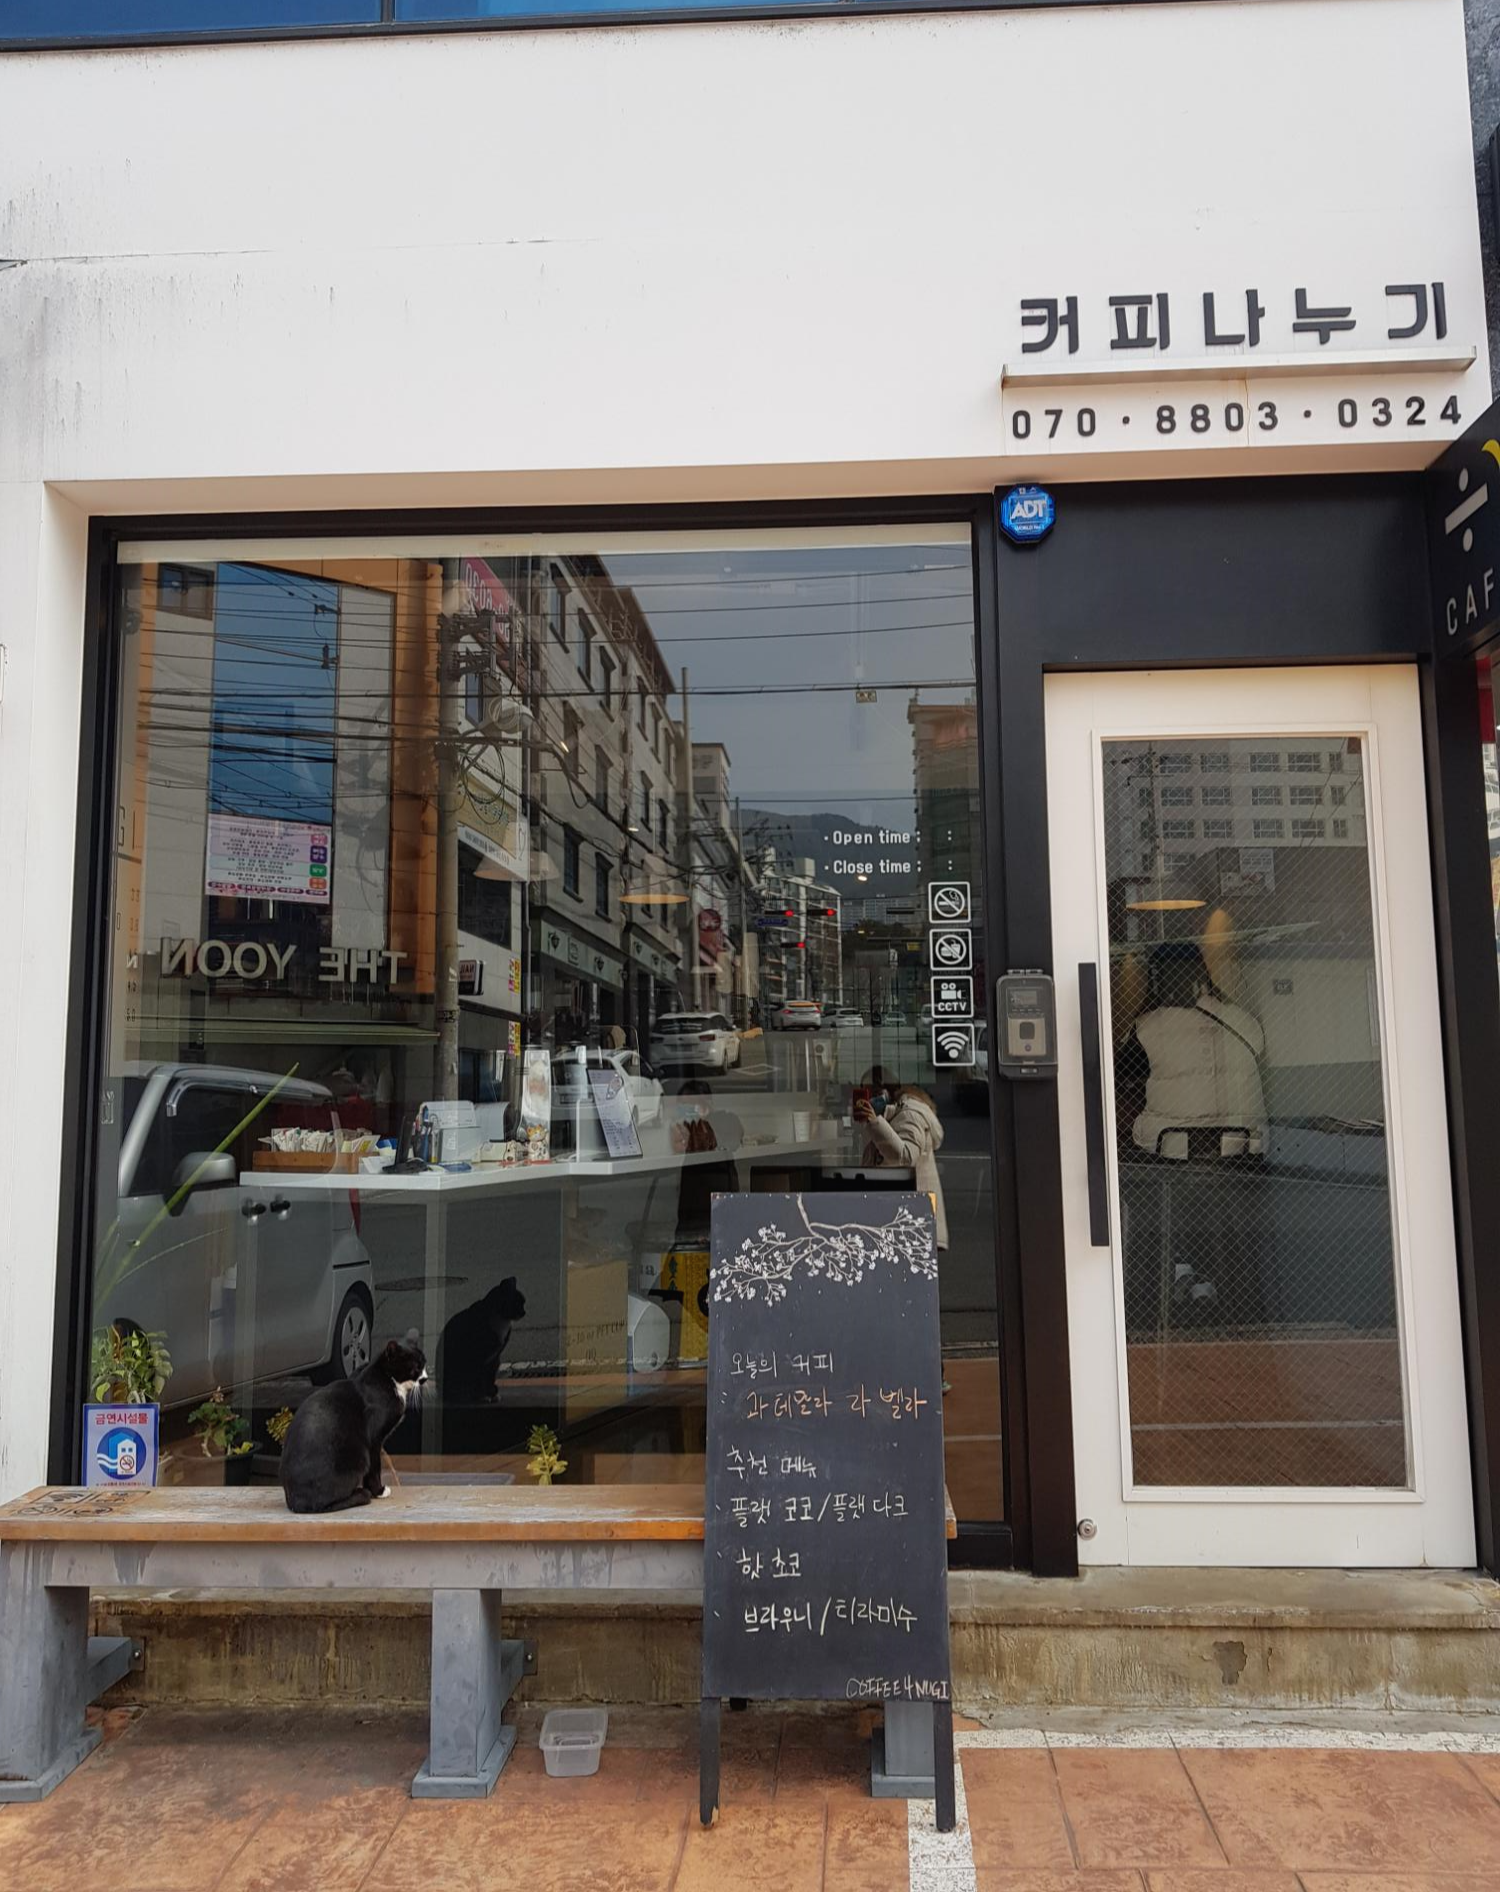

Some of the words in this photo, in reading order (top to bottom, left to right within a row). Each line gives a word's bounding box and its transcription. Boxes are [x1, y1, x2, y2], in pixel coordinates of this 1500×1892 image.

[1020, 282, 1447, 354] 커피나누기
[1010, 499, 1046, 519] ADT
[833, 830, 873, 846] Open
[833, 860, 873, 874] Close
[938, 1001, 967, 1012] CCTV
[730, 1351, 777, 1379] 오늘의
[792, 1351, 834, 1375] 커피
[95, 1412, 148, 1425] 금연시설물
[726, 1445, 768, 1479] 추천
[780, 1455, 817, 1478] 메뉴
[730, 1497, 771, 1528] 플랫
[735, 1547, 763, 1580] 핫
